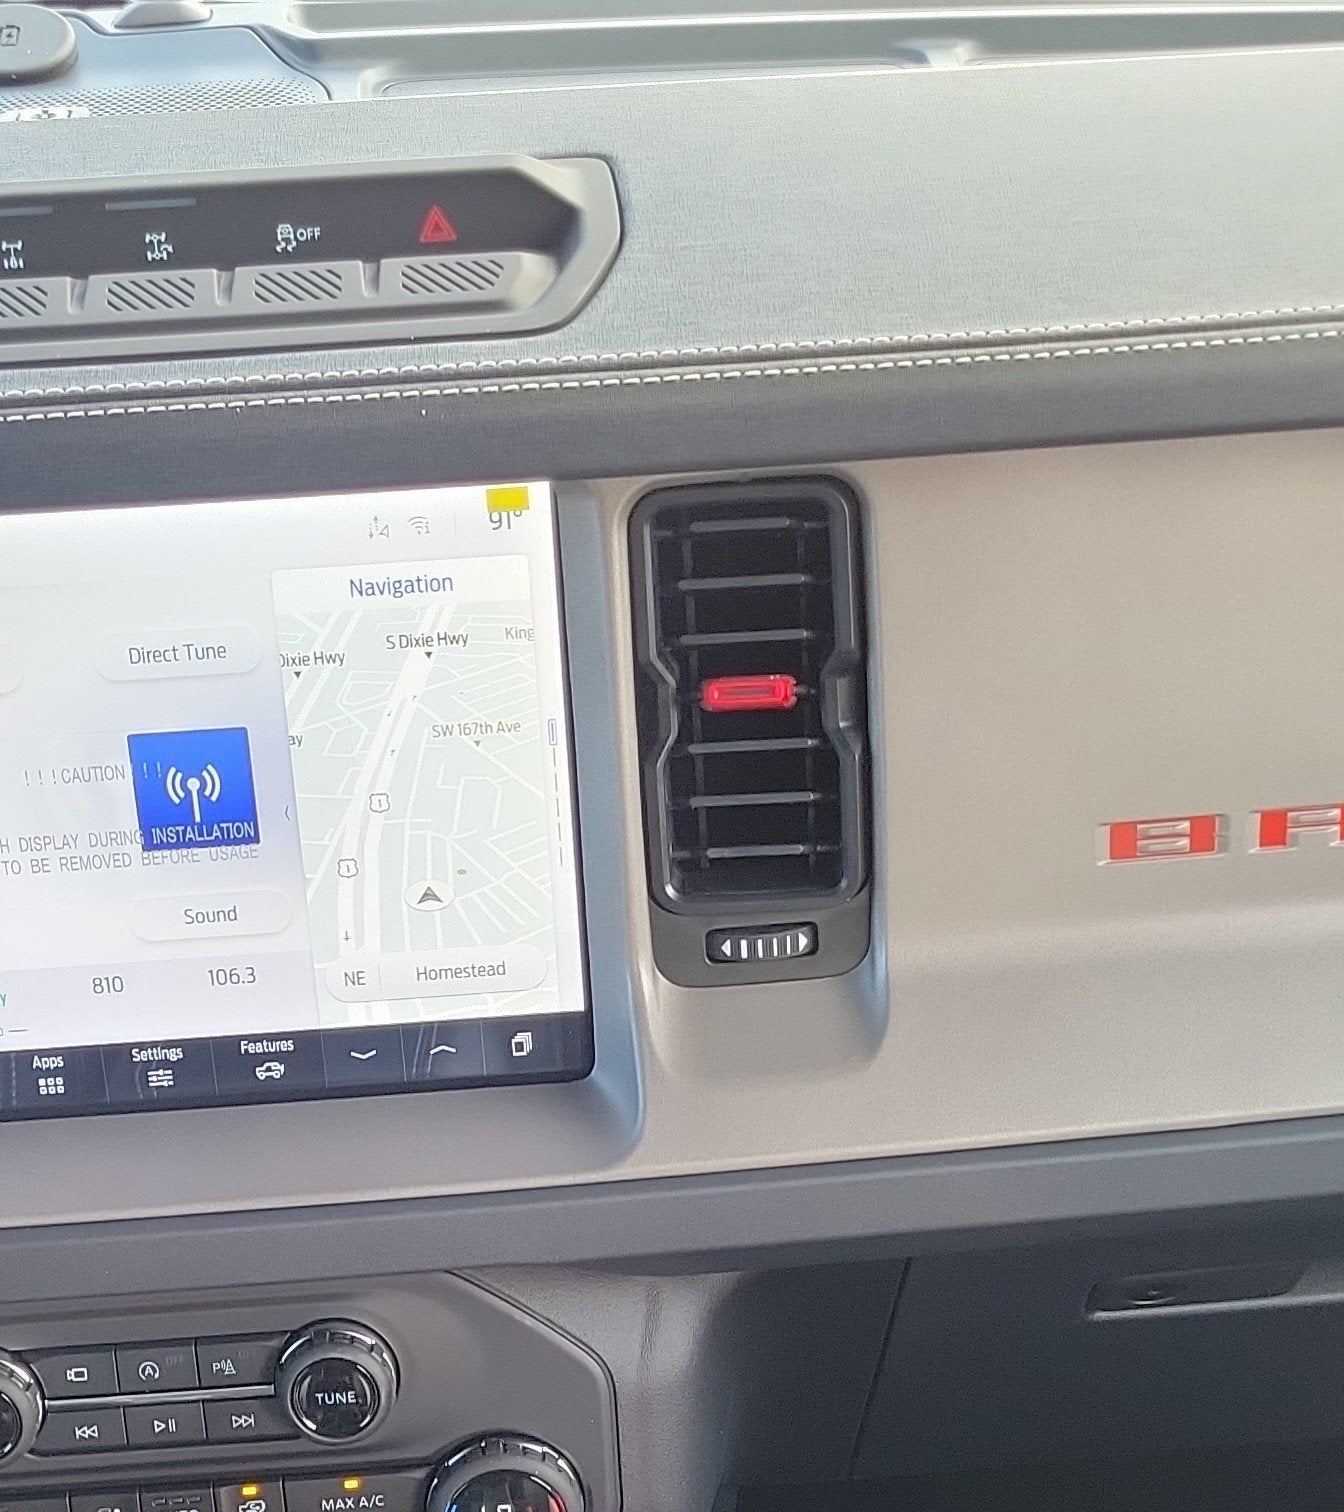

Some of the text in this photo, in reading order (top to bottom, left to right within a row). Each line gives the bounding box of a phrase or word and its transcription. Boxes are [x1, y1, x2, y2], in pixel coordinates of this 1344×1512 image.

[296, 227, 321, 241] OFF
[349, 574, 454, 599] Navigation
[386, 631, 469, 650] S Dixie Hwy
[128, 644, 227, 664] Direct Tune
[313, 650, 346, 668] Hwy
[432, 720, 522, 738] SW 167th Ave
[18, 833, 80, 852] DISPLAY
[88, 830, 144, 848] DURING
[151, 821, 255, 844] INSTALLATION
[0, 860, 22, 876] TO
[30, 858, 52, 874] BE
[58, 852, 132, 872] REMOVED
[142, 849, 201, 867] BEFORE
[208, 844, 258, 862] USAGE
[183, 904, 238, 926] Sound
[207, 966, 257, 988] 106.3
[343, 960, 507, 988] NE Homestead
[92, 974, 124, 996] 810
[131, 1046, 184, 1063] Settings
[239, 1037, 295, 1056] Features
[32, 1054, 65, 1071] Apps
[314, 1390, 356, 1406] TUNE
[320, 1494, 386, 1511] MAX A/C
